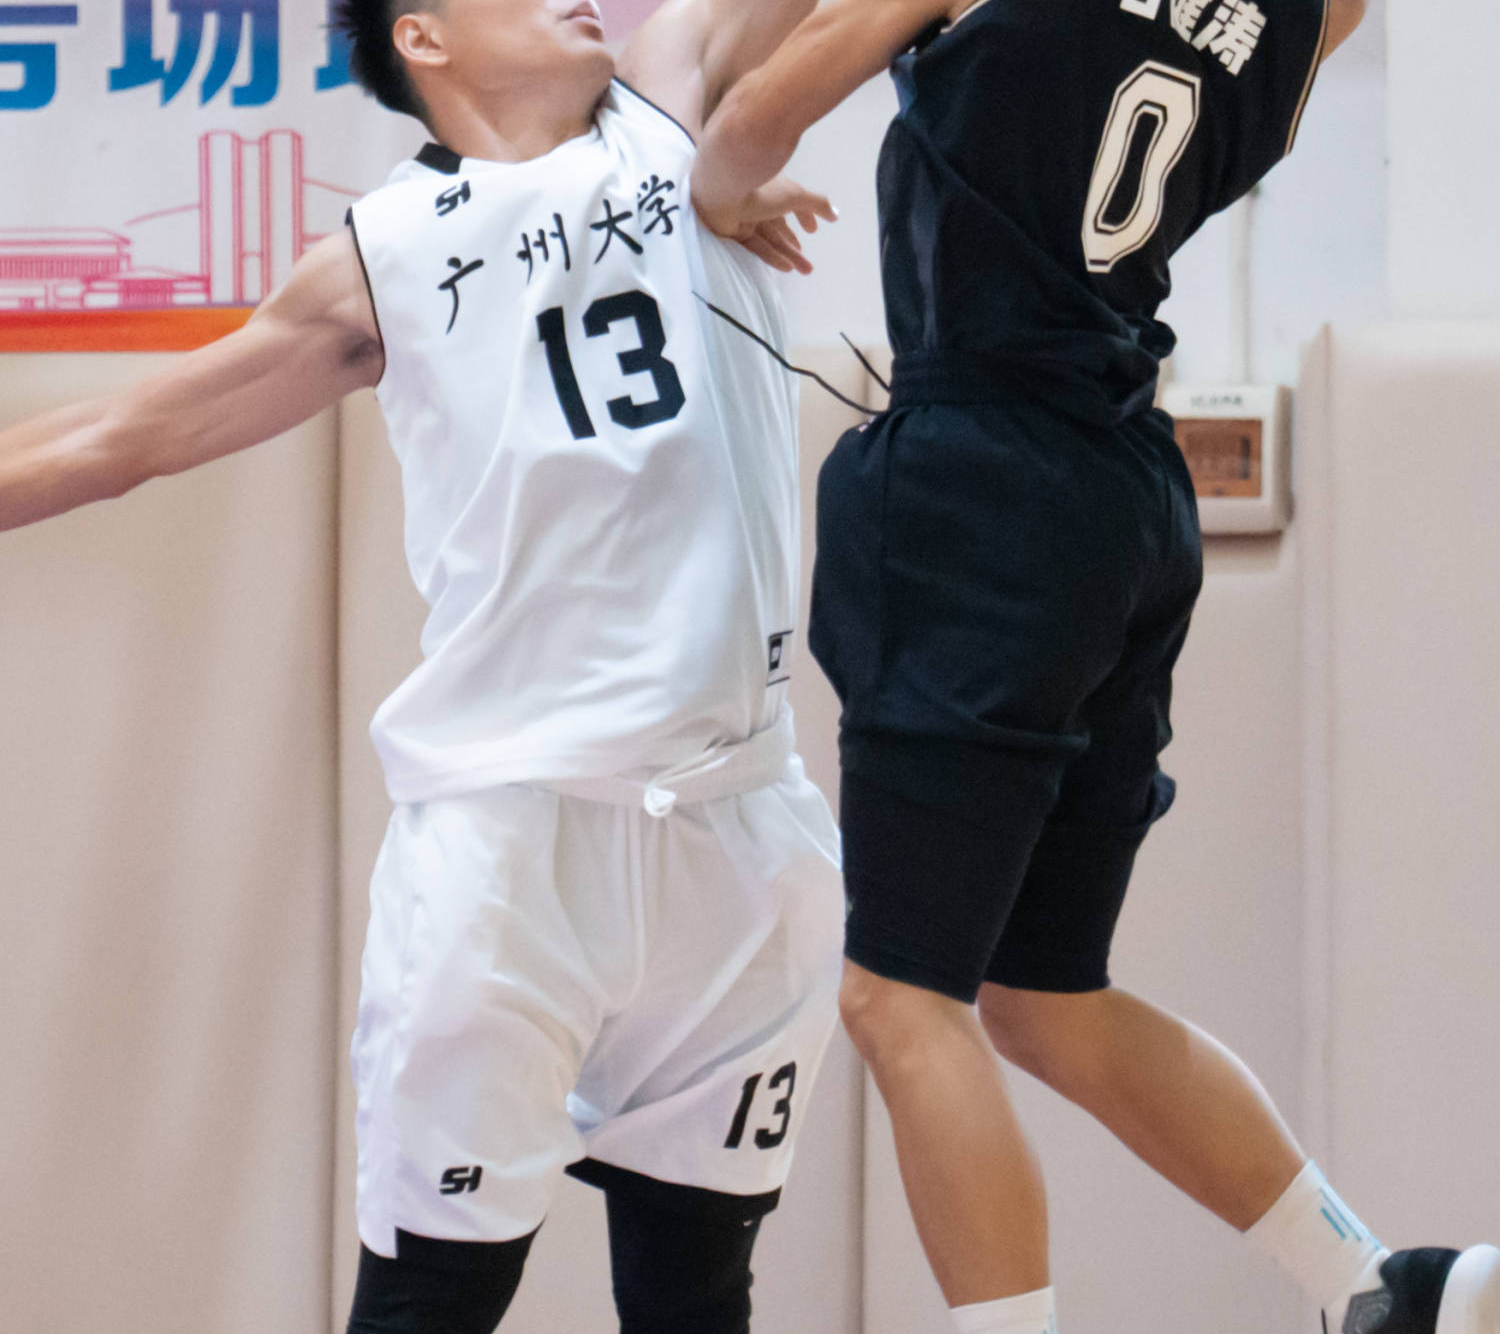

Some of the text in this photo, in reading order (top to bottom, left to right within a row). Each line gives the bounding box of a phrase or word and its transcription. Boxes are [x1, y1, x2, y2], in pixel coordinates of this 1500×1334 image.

[1081, 59, 1202, 274] 0
[437, 174, 682, 335] 广州大学
[535, 289, 686, 441] 13
[723, 1060, 797, 1151] 13
